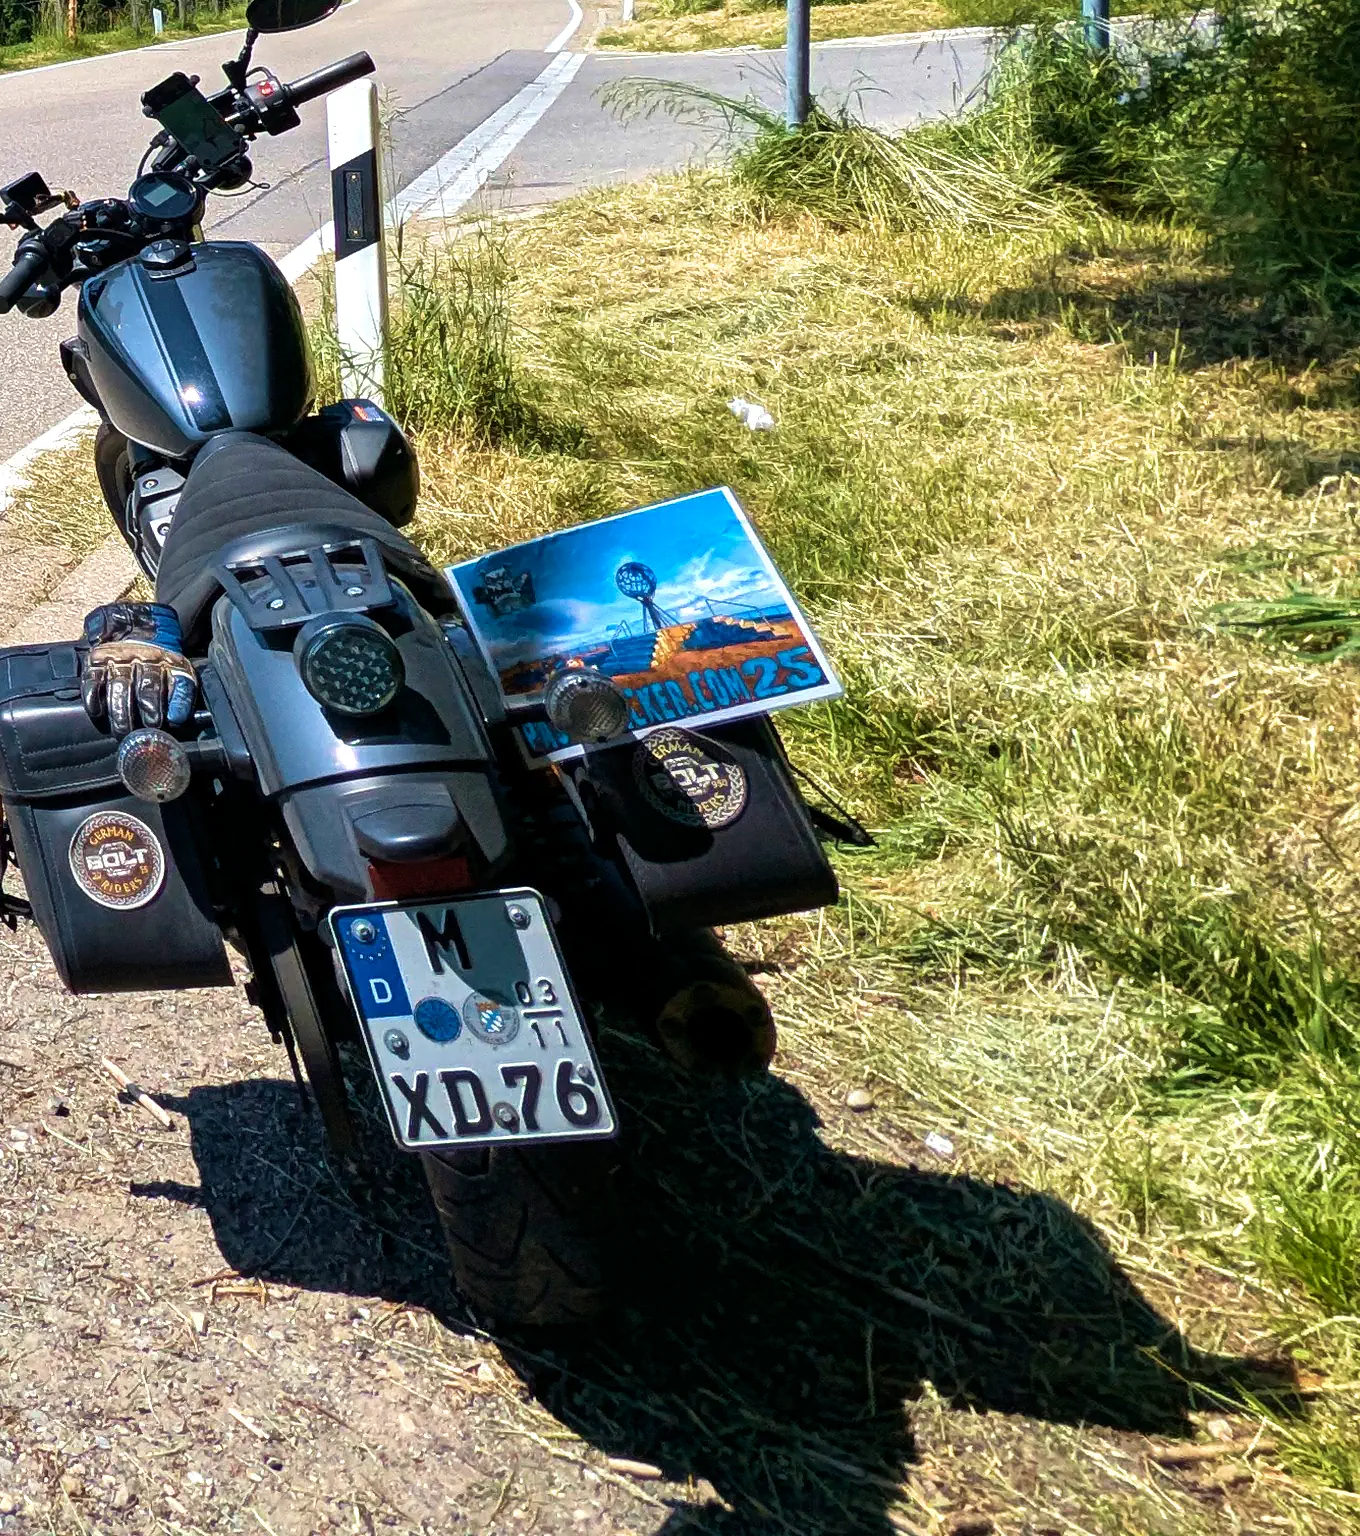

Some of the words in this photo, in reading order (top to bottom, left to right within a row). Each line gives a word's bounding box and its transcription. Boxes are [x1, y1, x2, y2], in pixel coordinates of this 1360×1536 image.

[89, 826, 135, 846] GERMAN
[85, 848, 148, 871] BOLT
[101, 877, 143, 893] RIDERS
[416, 909, 473, 975] M
[369, 978, 393, 1004] D
[513, 976, 557, 1007] 03
[530, 1019, 570, 1051] 11
[390, 1066, 495, 1140] XD
[497, 1059, 601, 1133] 76
